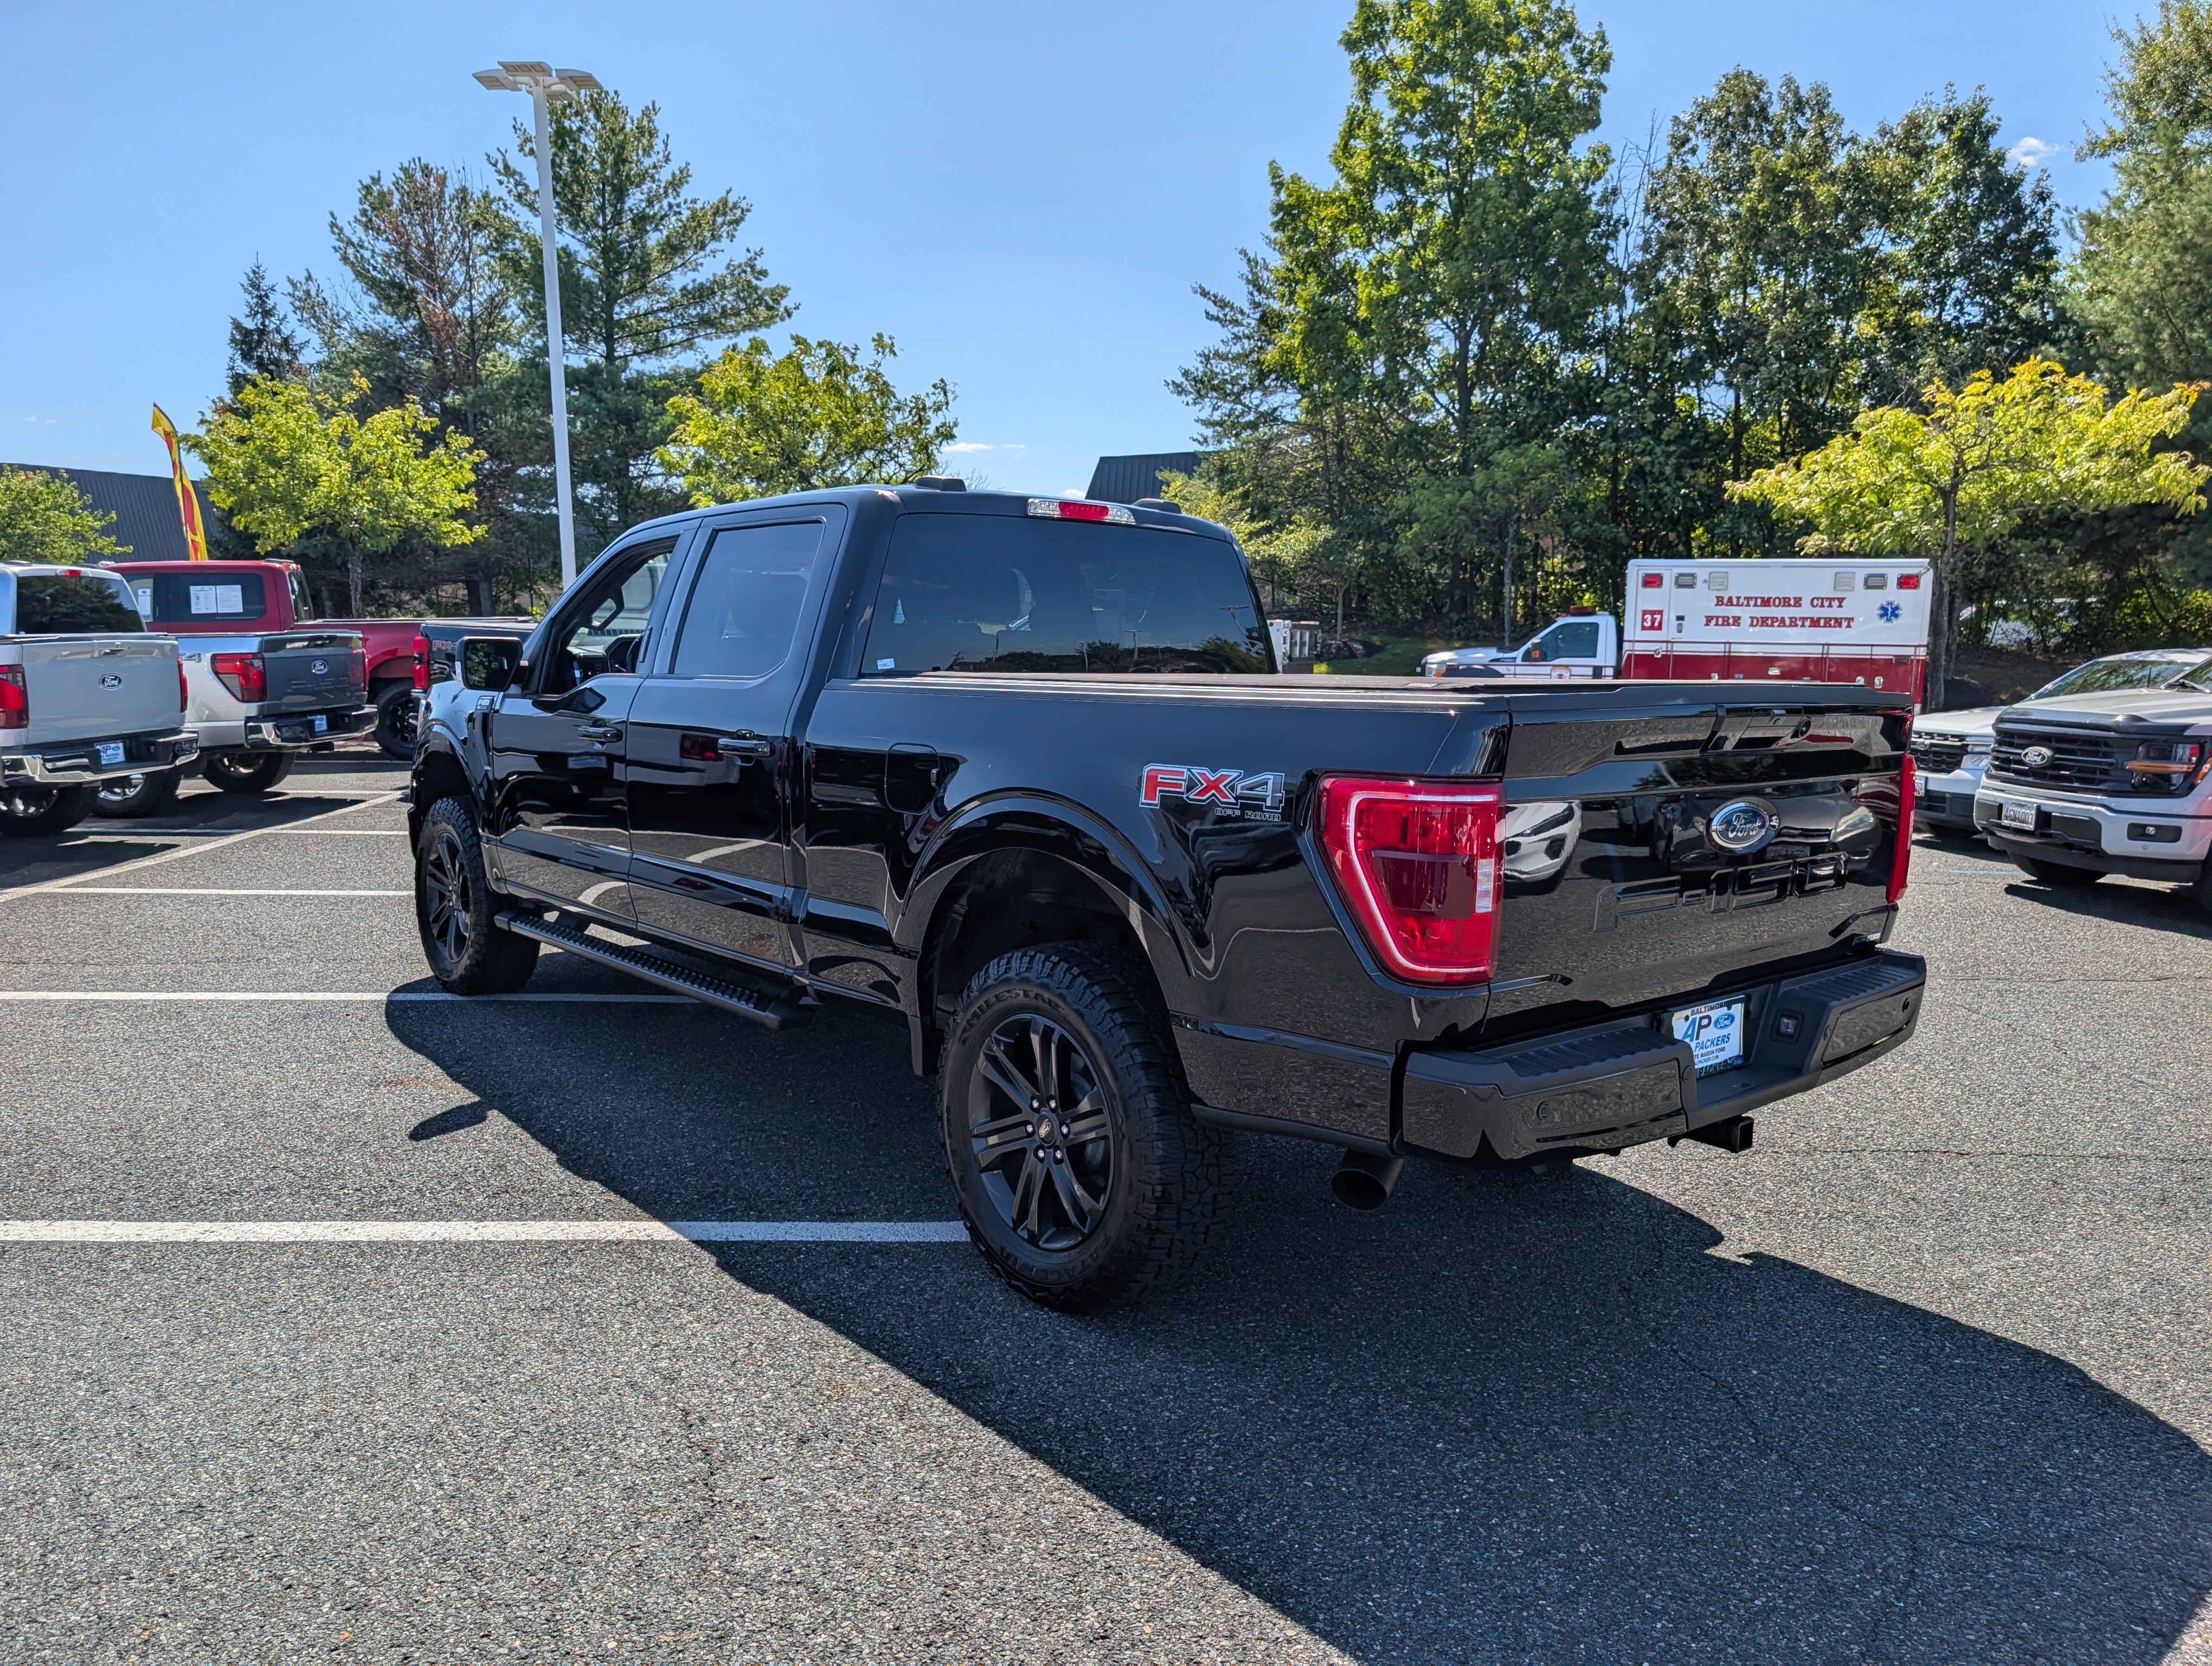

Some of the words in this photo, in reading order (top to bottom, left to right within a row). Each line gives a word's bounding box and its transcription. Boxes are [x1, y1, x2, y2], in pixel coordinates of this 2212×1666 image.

[1714, 595, 1803, 608] BALTIMORE
[1810, 596, 1847, 608] CITY
[1643, 614, 1661, 627] 37
[1703, 615, 1741, 627] FIRE
[1748, 616, 1855, 629] DEPARTMENT
[2025, 751, 2043, 762] Ford
[1139, 763, 1285, 812] FX4
[1214, 808, 1241, 817] OFF
[1244, 811, 1281, 821] ROAD
[1728, 812, 1762, 838] Ford
[1593, 851, 1849, 933] F-150
[963, 987, 1062, 1031] MILESTAR
[1690, 1002, 1728, 1016] BALTIMORE
[1681, 1014, 1712, 1042] AP
[1694, 1033, 1731, 1053] PACKERS
